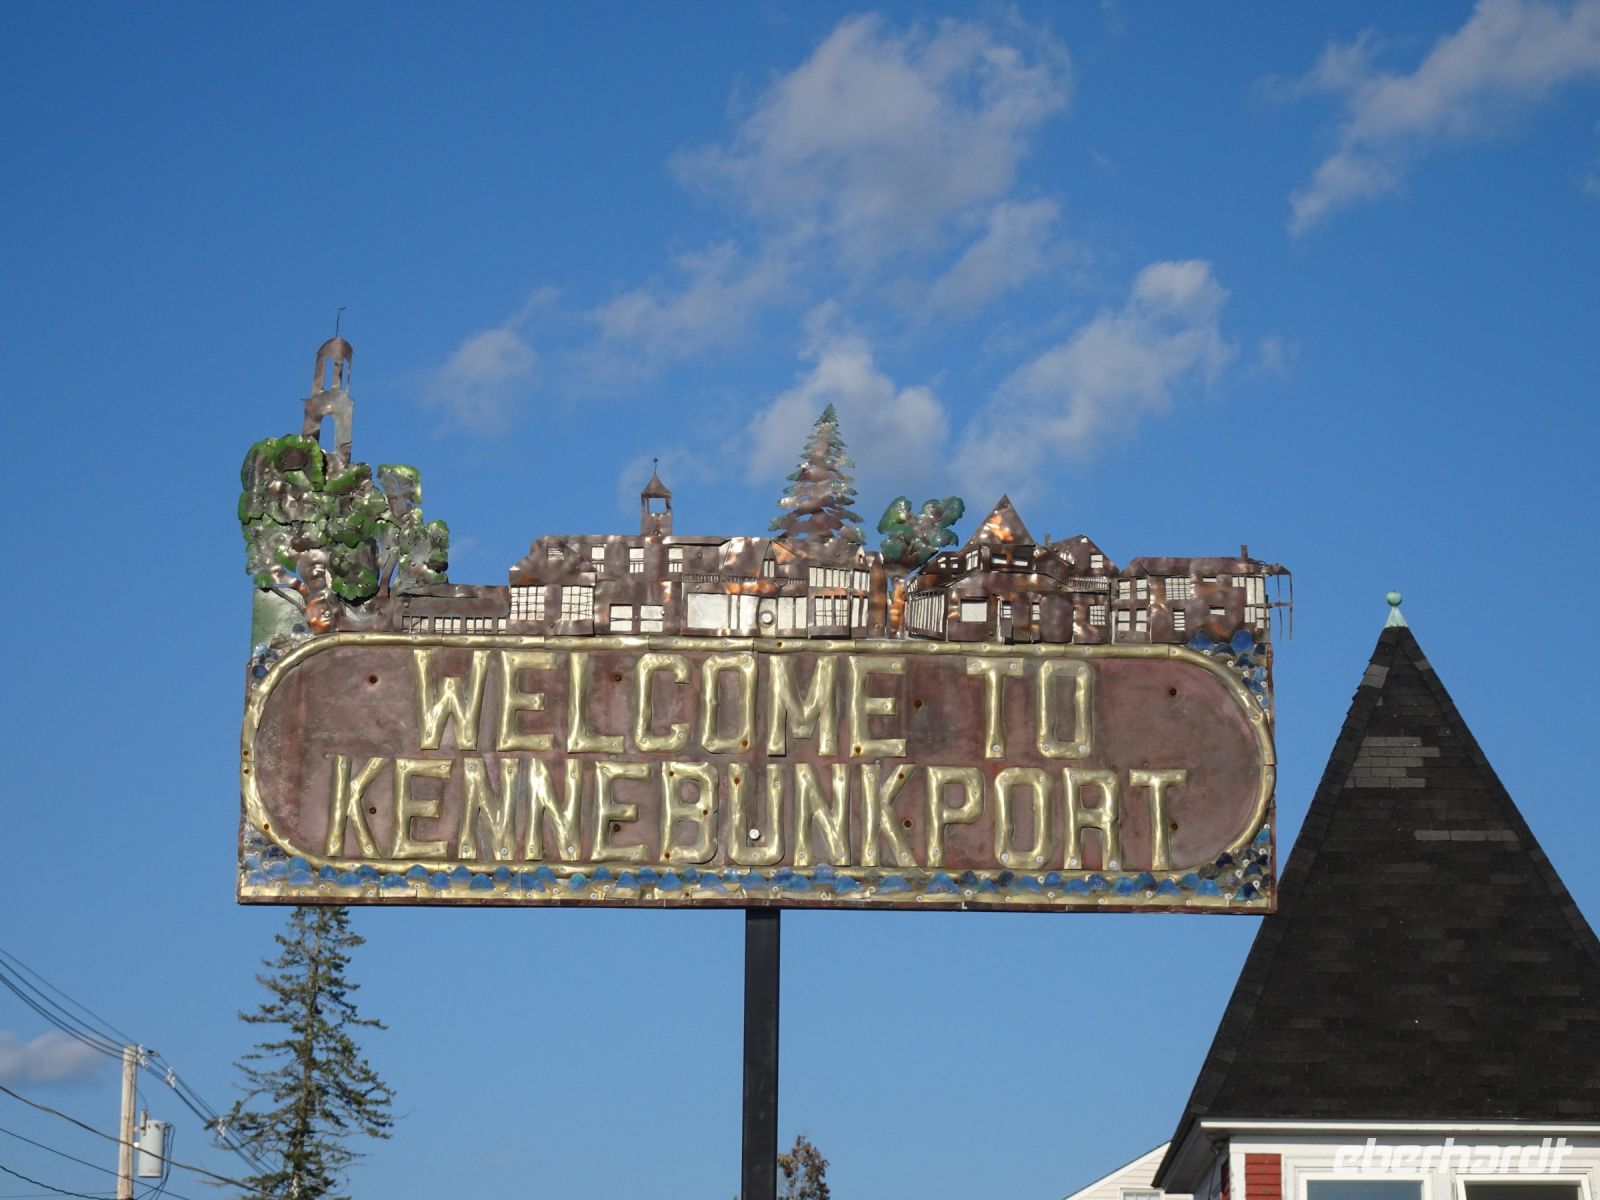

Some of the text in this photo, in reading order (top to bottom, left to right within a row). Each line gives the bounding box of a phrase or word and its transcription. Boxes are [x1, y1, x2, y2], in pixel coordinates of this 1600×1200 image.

[413, 649, 1096, 759] WELCOME TO
[325, 754, 1188, 871] KENNEBUNKPORT
